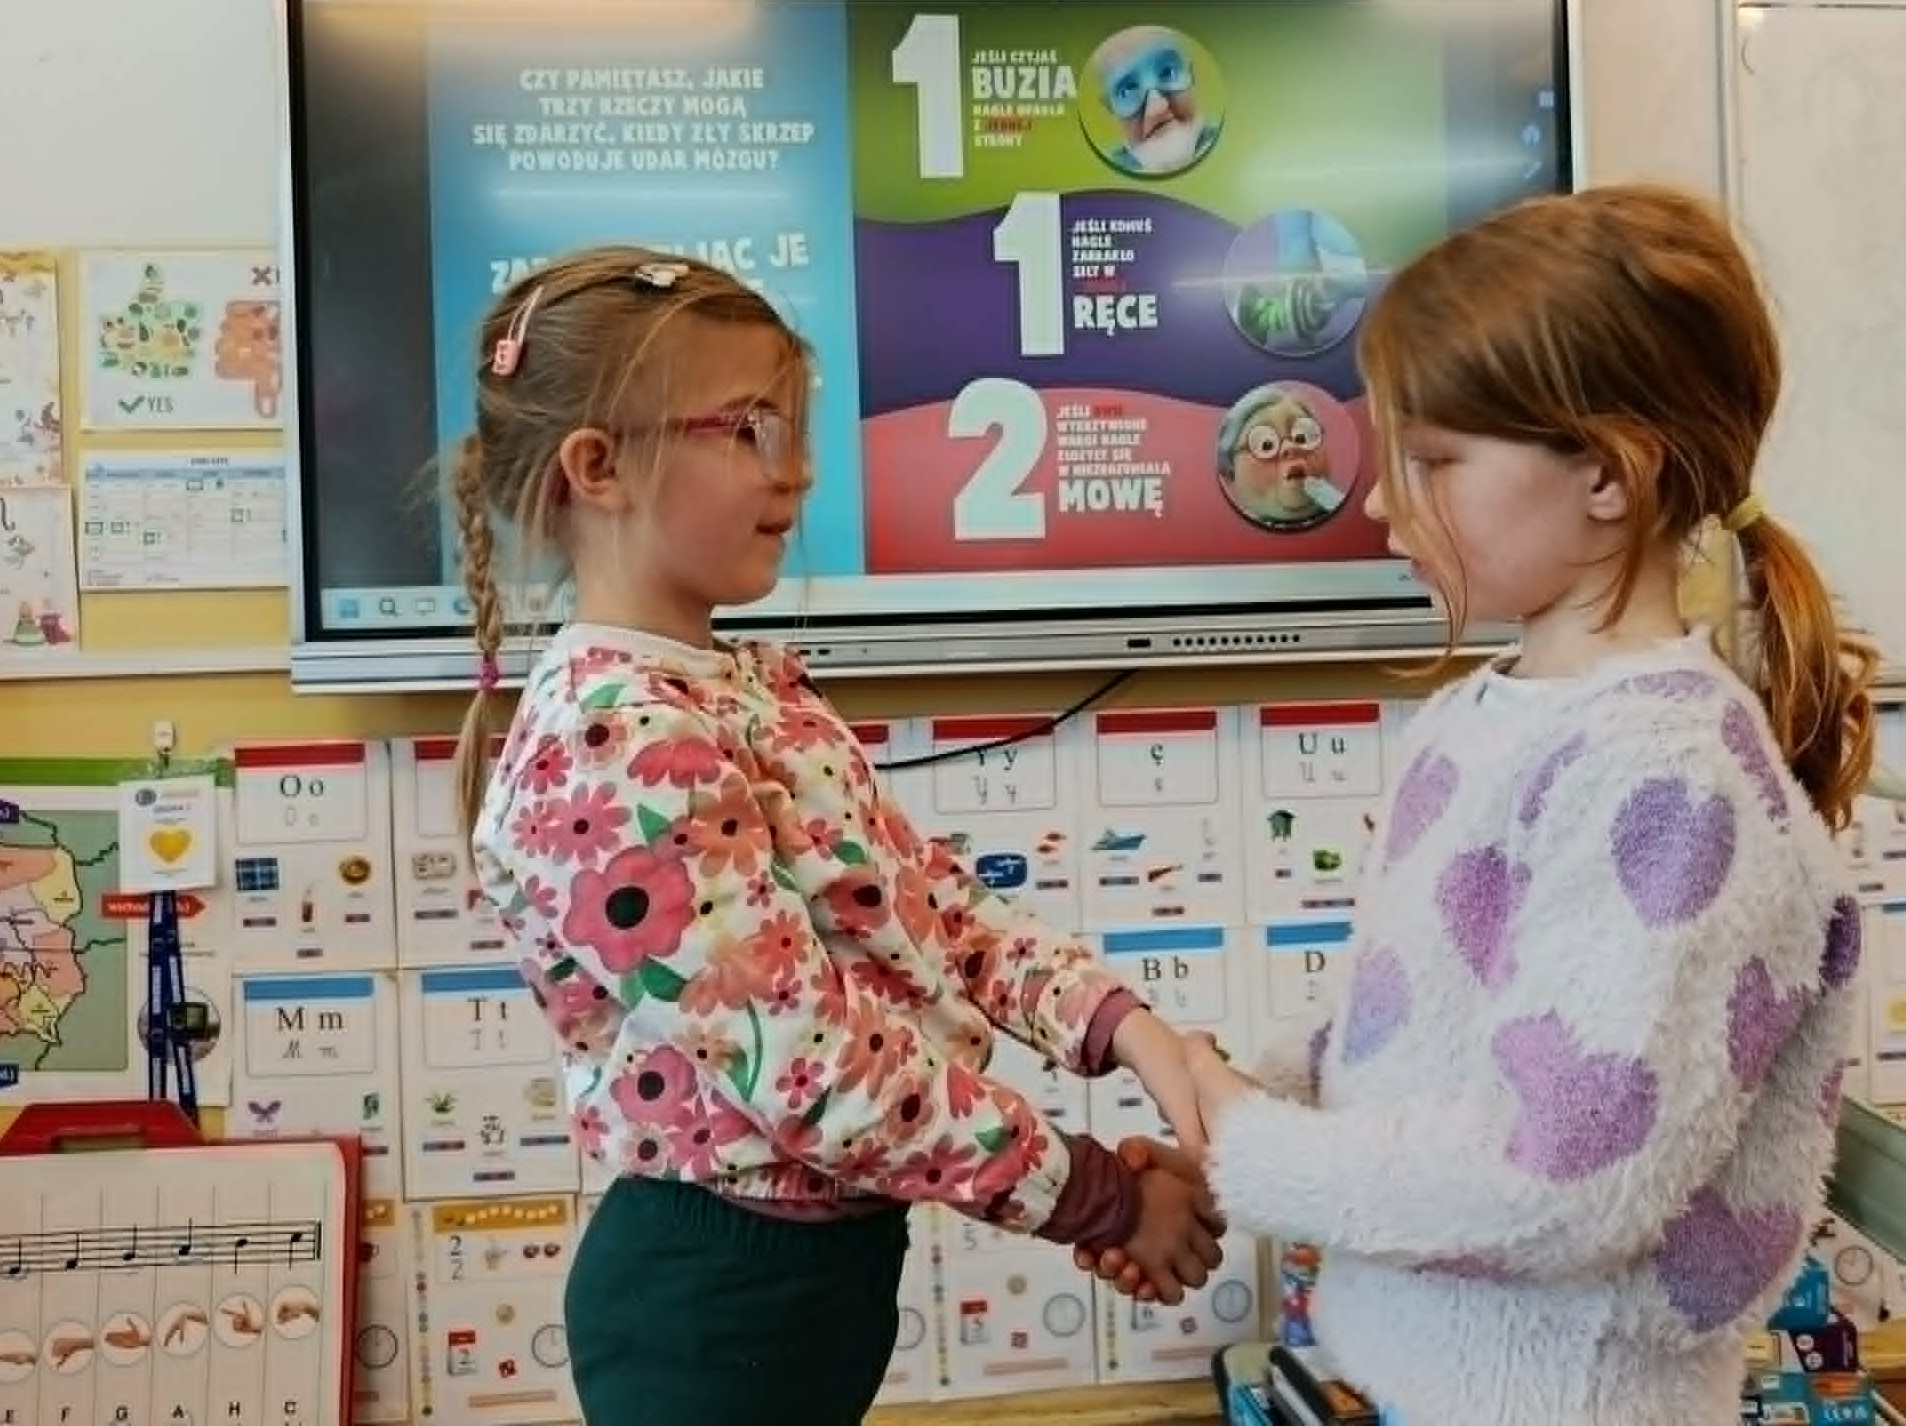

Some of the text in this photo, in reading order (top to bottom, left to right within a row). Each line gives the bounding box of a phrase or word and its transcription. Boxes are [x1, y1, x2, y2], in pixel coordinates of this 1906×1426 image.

[520, 68, 557, 90] CZY
[702, 67, 764, 89] JAKIE
[972, 66, 1077, 98] BUZIA
[539, 97, 747, 119] TRZY RZECZY MOGĄ
[892, 14, 963, 178] 1
[474, 123, 508, 149] SIĘ
[625, 122, 684, 145] KIEDY
[691, 122, 731, 144] ZŁY
[739, 122, 815, 146] SKRZEP
[509, 148, 780, 170] POWODUJE UDAR MÓZGU?
[770, 233, 809, 267] JE
[994, 193, 1064, 354] 1
[1073, 294, 1158, 336] RĘCE
[147, 395, 174, 413] YES
[949, 378, 1047, 540] 2
[1058, 478, 1163, 518] MOWĘ
[1299, 733, 1346, 755] U u
[1002, 749, 1018, 770] y
[280, 774, 324, 798] O o
[1143, 956, 1188, 981] B b
[1304, 951, 1326, 974] D
[276, 1006, 345, 1031] M m
[468, 997, 508, 1021] T t
[172, 1403, 186, 1418] A
[228, 1401, 241, 1417] H
